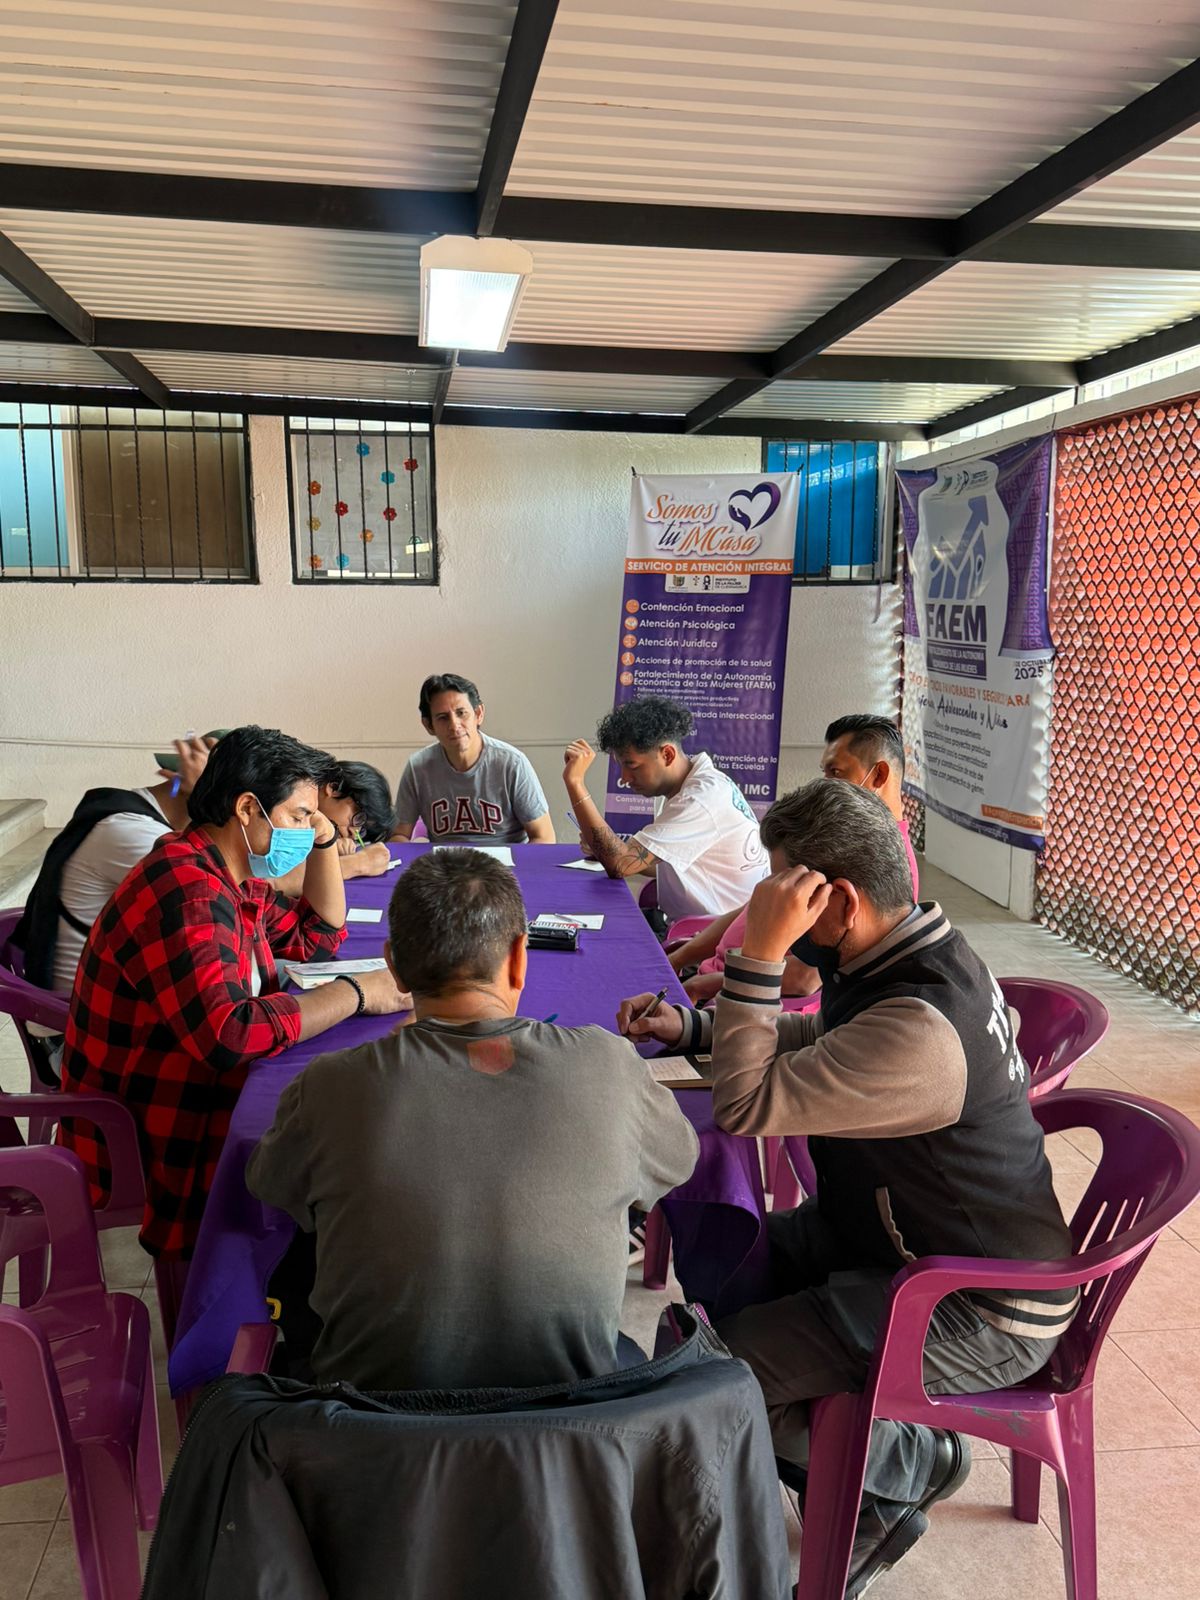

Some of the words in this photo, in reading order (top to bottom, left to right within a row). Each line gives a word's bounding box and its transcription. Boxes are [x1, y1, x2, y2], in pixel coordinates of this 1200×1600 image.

[647, 494, 714, 520] Somos
[658, 520, 682, 546] tu
[627, 561, 673, 571] SERVICIO
[675, 562, 688, 572] DE
[690, 560, 742, 572] ATENCIÓN
[744, 562, 792, 572] INTEGRAL
[641, 602, 693, 612] Contención
[696, 603, 744, 613] Emocional
[639, 618, 680, 629] Atención
[682, 620, 735, 631] Psicológica
[926, 603, 987, 643] FAEM
[638, 637, 679, 647] Atención
[681, 638, 718, 649] Jurídica
[635, 657, 671, 665] Acciones
[673, 658, 683, 666] de
[685, 657, 726, 668] promoción
[728, 659, 739, 667] de
[741, 659, 748, 667] la
[750, 659, 772, 667] salud
[634, 670, 699, 681] Fortalecimiento
[701, 671, 712, 680] de
[714, 672, 722, 680] la
[725, 672, 772, 681] Autonomía
[1014, 665, 1044, 681] 2025
[633, 677, 681, 687] Económica
[682, 678, 693, 687] de
[696, 679, 708, 688] las
[710, 680, 744, 690] Mujeres
[745, 680, 776, 691] (FAEM)
[713, 753, 756, 763] Prevención
[758, 754, 768, 763] de
[770, 755, 777, 763] la
[719, 761, 730, 769] las
[732, 762, 765, 771] Escuelas
[744, 783, 770, 796] IMC
[430, 796, 504, 837] GAP
